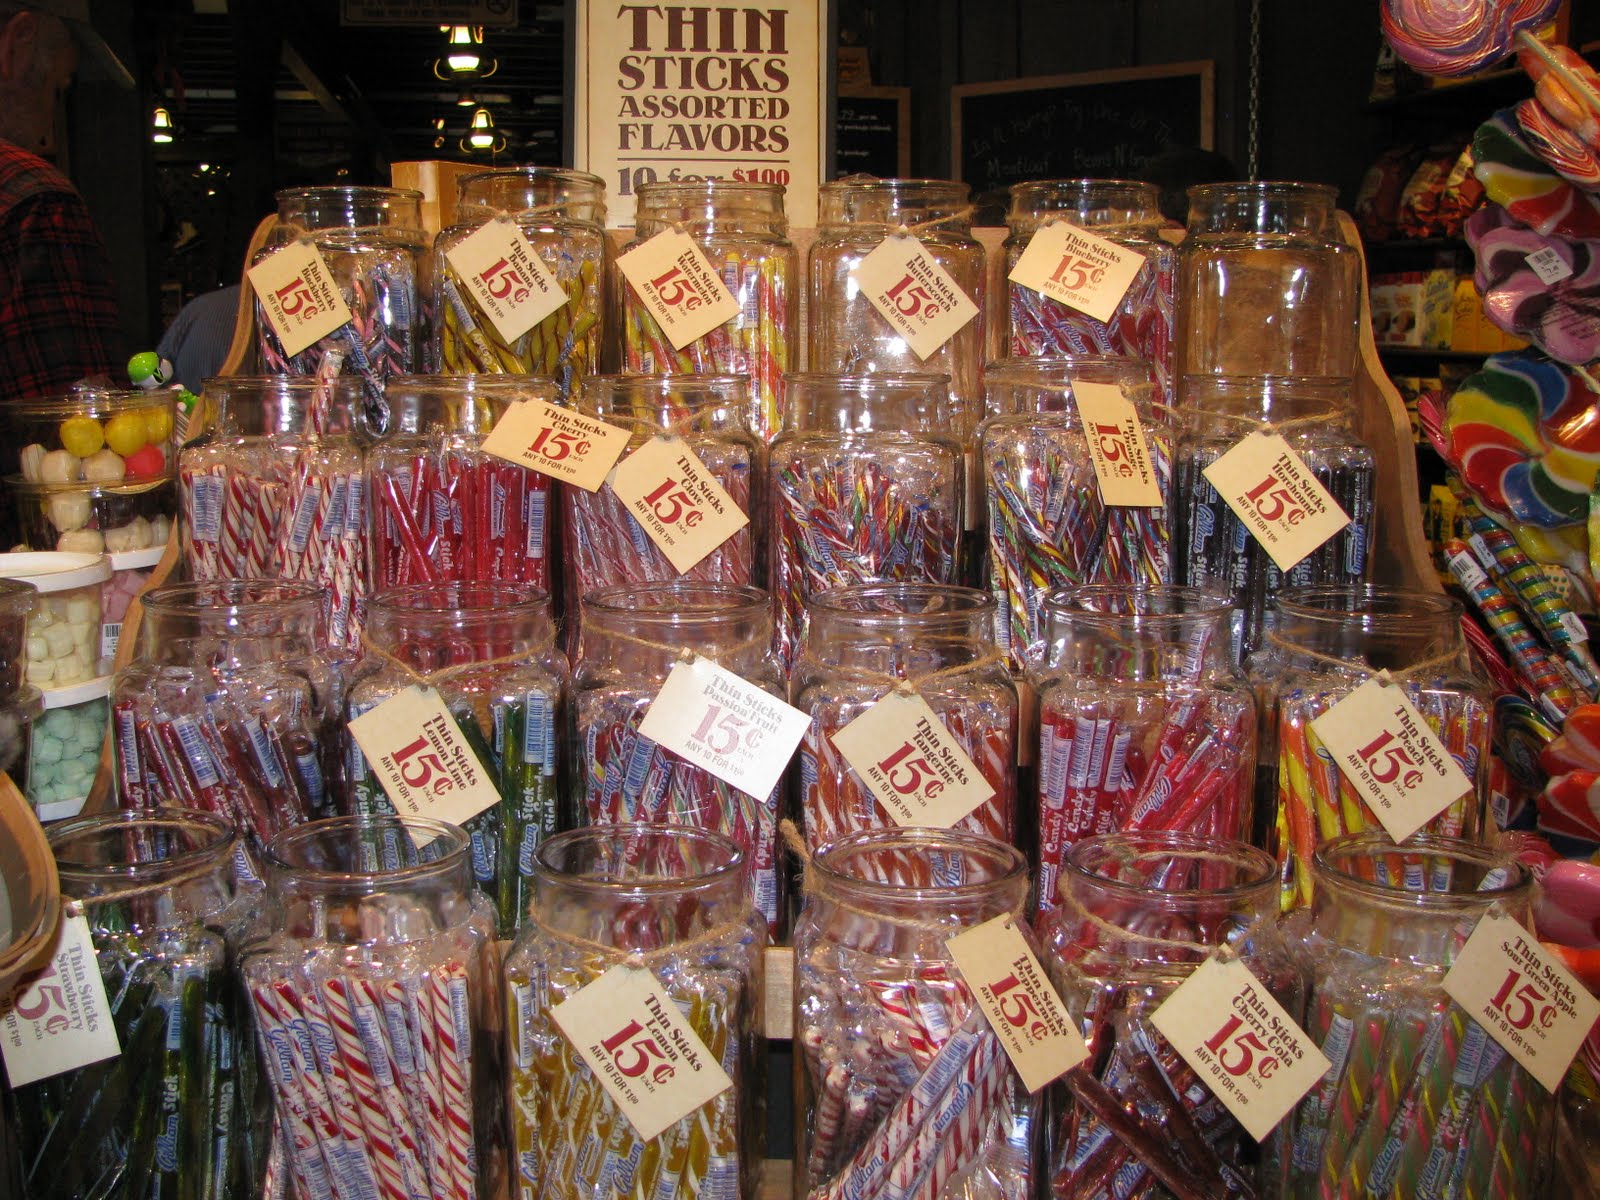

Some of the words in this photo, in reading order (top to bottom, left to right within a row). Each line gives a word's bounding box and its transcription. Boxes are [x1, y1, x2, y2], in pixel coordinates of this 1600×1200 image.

[617, 5, 789, 54] THIN
[617, 55, 790, 93] STICKS
[617, 95, 790, 120] ASSORTED
[617, 123, 790, 153] FLAVORS
[508, 253, 534, 289] Banana
[510, 237, 528, 263] Thin
[525, 262, 548, 293] Sticks
[1048, 254, 1105, 290] 15¢
[1065, 232, 1089, 249] Thin
[1089, 243, 1121, 263] Sticks
[1065, 243, 1110, 269] Blueberry
[275, 276, 322, 320] 15¢
[301, 267, 326, 312] Blackberry
[308, 259, 322, 283] Thin
[319, 281, 336, 311] Sticks
[472, 276, 483, 289] ANY
[484, 294, 497, 309] FOR
[479, 257, 530, 303] 15¢
[642, 282, 654, 295] ANY
[655, 301, 667, 314] FOR
[650, 265, 703, 311] 15¢
[677, 255, 713, 306] Watermelon
[683, 248, 702, 273] Thin
[699, 272, 721, 302] Sticks
[885, 273, 940, 319] 15¢
[906, 259, 951, 313] Butterscotch
[913, 253, 934, 279] Thin
[932, 276, 958, 307] Sticks
[878, 295, 891, 307] ANY
[894, 313, 907, 326] FOR
[527, 427, 591, 461] 15¢
[544, 408, 570, 424] Thin
[571, 419, 606, 437] Sticks
[552, 420, 588, 439] Cherry
[522, 451, 538, 460] ANY
[546, 460, 562, 470] FOR
[1095, 422, 1134, 478] 15¢
[1123, 431, 1137, 469] Orange
[1125, 419, 1138, 445] Thin
[1134, 448, 1148, 485] Sticks
[643, 477, 704, 527] 15¢
[677, 455, 698, 483] Thin
[697, 481, 724, 515] Sticks
[681, 478, 703, 505] Clove
[1245, 474, 1306, 525] 15¢
[1272, 463, 1317, 516] Horehound
[1278, 452, 1300, 481] Thin
[1298, 479, 1326, 514] Sticks
[634, 500, 649, 514] ANY
[651, 520, 665, 535] FOR
[1236, 496, 1251, 510] ANY
[1248, 509, 1257, 519] 10
[1254, 516, 1268, 532] FOR
[703, 684, 751, 717] Passion
[749, 710, 778, 734] Fruit
[711, 674, 742, 700] Thin
[743, 693, 783, 724] Sticks
[422, 720, 449, 761] Lemon
[446, 759, 466, 790] Lime
[432, 712, 454, 746] Thin
[450, 745, 477, 786] Sticks
[685, 740, 703, 753] ANY
[702, 749, 712, 760] 10
[711, 754, 729, 769] FOR
[690, 704, 763, 756] 15¢
[916, 716, 940, 749] Thin
[938, 747, 969, 785] Sticks
[1394, 704, 1419, 738] Thin
[1416, 736, 1447, 776] Sticks
[1397, 729, 1425, 766] Peach
[380, 756, 395, 772] ANY
[391, 773, 401, 782] 10
[396, 781, 410, 799] FOR
[390, 735, 454, 796] 15¢
[877, 741, 945, 799] 15¢
[912, 730, 954, 785] Tangerine
[1347, 754, 1363, 770] ANY
[1360, 770, 1370, 780] 10
[1366, 778, 1381, 796] FOR
[1356, 729, 1424, 789] 15¢
[867, 767, 884, 782] ANY
[880, 782, 890, 792] 10
[886, 790, 902, 807] FOR
[1046, 813, 1064, 852] Candy
[51, 953, 83, 1030] Strawberry
[68, 942, 86, 982] Thin
[78, 984, 98, 1032] Sticks
[1019, 952, 1041, 989] Thin
[1040, 991, 1068, 1036] Sticks
[1501, 941, 1523, 966] Sour
[1523, 963, 1550, 993] Green
[1550, 990, 1577, 1019] Apple
[1514, 936, 1541, 970] Thin
[1541, 965, 1576, 1005] Sticks
[980, 987, 995, 1004] ANY
[992, 1006, 1001, 1017] 10
[998, 1017, 1012, 1037] FOR
[988, 972, 1048, 1041] 15¢
[1012, 960, 1060, 1037] Peppermint
[1240, 983, 1269, 1020] Thin
[1267, 1016, 1304, 1060] Sticks
[1490, 968, 1557, 1030] 15¢
[644, 993, 671, 1029] Thin
[668, 1028, 703, 1072] Sticks
[645, 1018, 678, 1062] Lemon
[1204, 1013, 1279, 1079] 15¢
[1232, 996, 1269, 1038] Cherry
[1267, 1035, 1293, 1068] Cola
[1483, 1005, 1500, 1023] ANY
[1499, 1020, 1509, 1032] 10
[1507, 1028, 1523, 1046] FOR
[589, 1045, 607, 1062] ANY
[603, 1062, 614, 1073] 10
[610, 1071, 627, 1091] FOR
[600, 1019, 676, 1084] 15¢
[1194, 1047, 1213, 1064] ANY
[1210, 1063, 1221, 1075] 10
[1218, 1072, 1235, 1092] FOR
